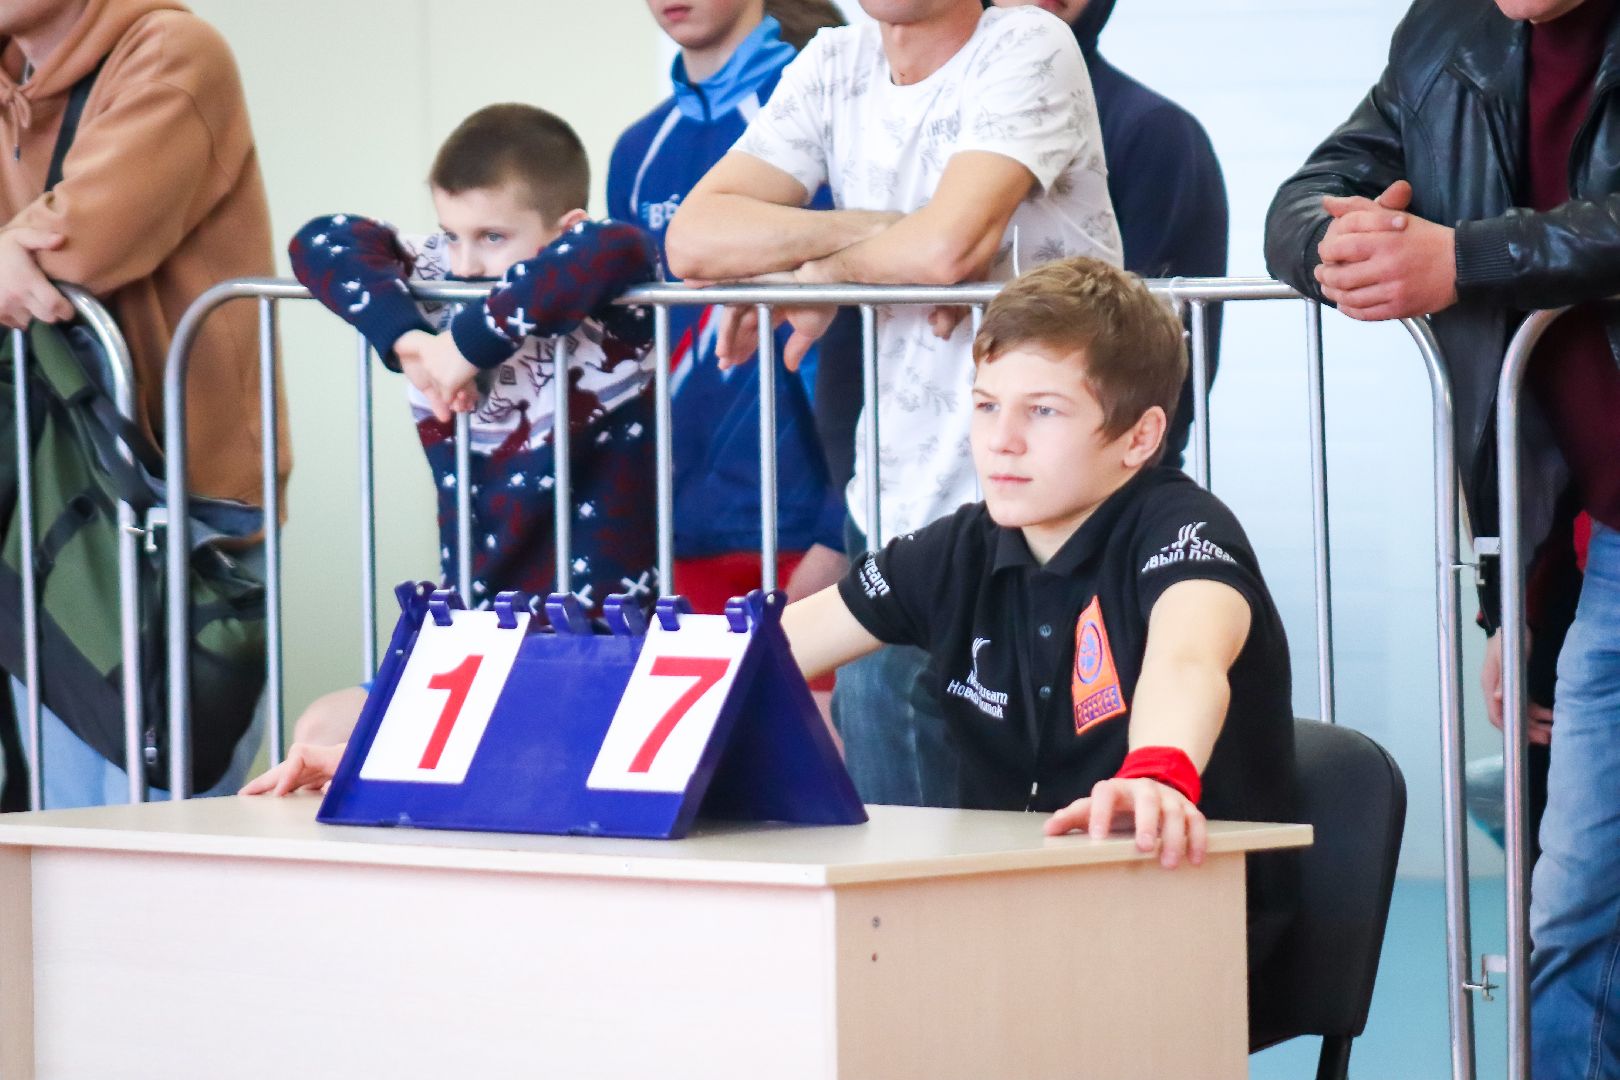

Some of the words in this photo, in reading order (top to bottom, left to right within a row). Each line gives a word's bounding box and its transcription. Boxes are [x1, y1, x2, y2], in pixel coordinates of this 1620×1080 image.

[418, 654, 484, 770] 1
[627, 655, 732, 773] 7
[1077, 686, 1120, 724] REFEREE
